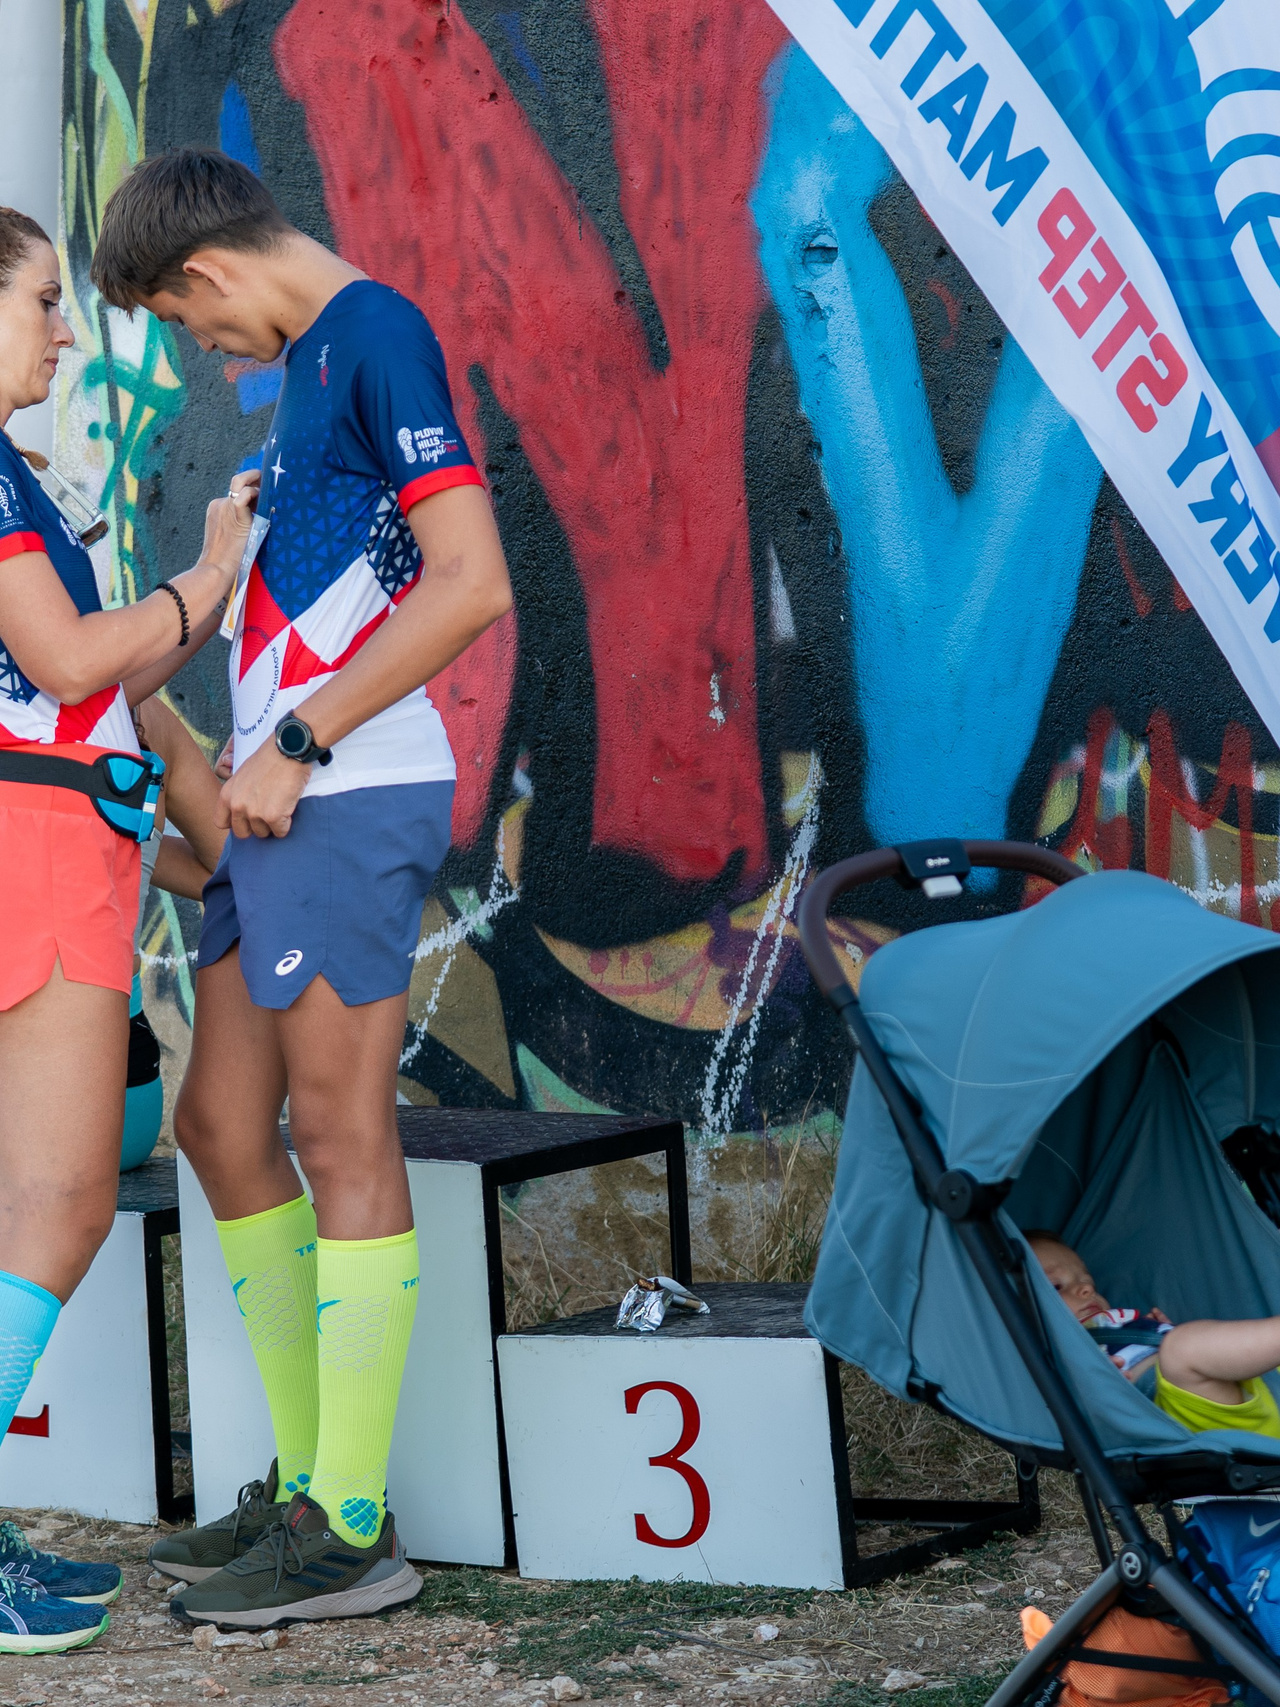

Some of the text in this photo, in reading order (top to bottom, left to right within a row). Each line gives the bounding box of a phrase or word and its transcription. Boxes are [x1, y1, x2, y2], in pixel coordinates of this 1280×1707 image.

[413, 427, 444, 440] PLOVDIV
[417, 436, 441, 450] HILLS
[421, 444, 447, 463] Night
[270, 646, 280, 686] PLOVDIV
[263, 688, 277, 715] HILLS
[257, 715, 265, 725] IN
[295, 1240, 317, 1257] TR
[624, 1381, 711, 1549] 3
